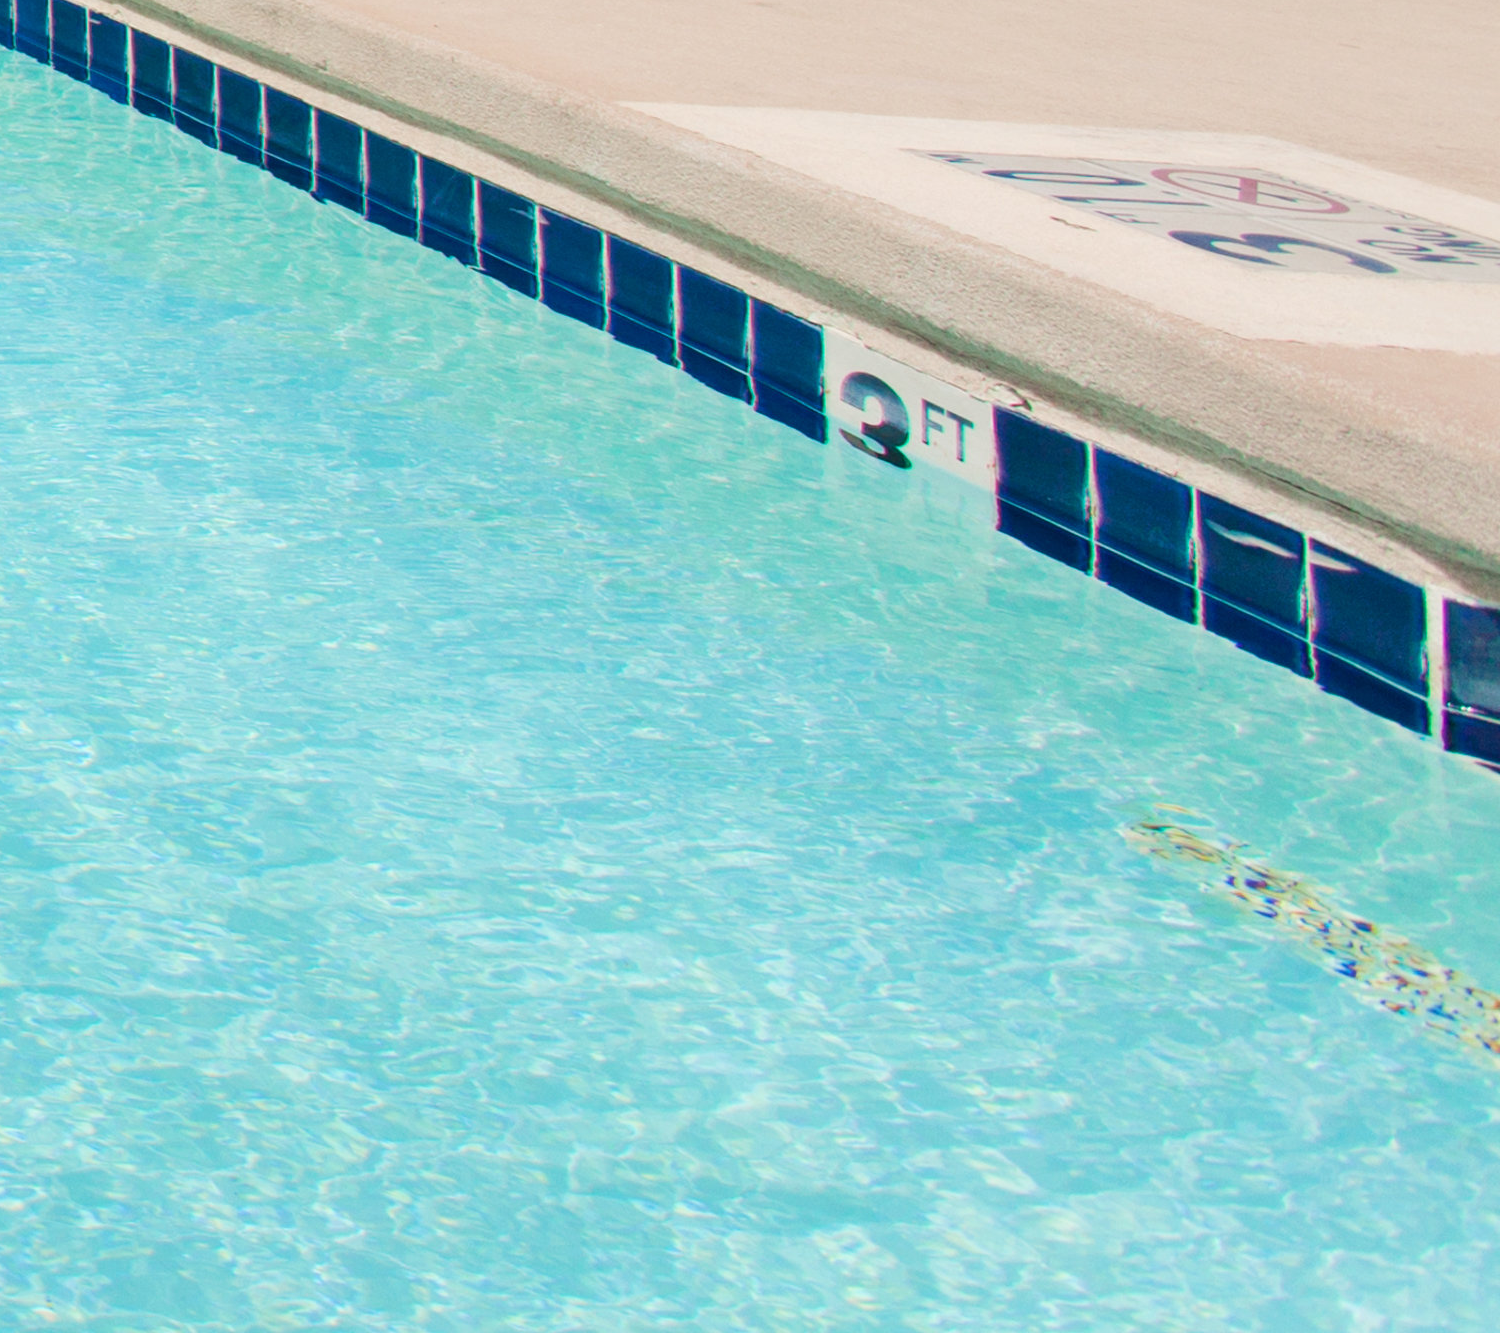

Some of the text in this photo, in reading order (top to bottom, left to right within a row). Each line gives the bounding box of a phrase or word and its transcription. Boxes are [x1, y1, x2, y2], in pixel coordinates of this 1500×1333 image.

[1094, 210, 1160, 225] FT
[1167, 230, 1398, 274] 3
[1356, 239, 1481, 266] NO
[839, 370, 975, 469] 3 FT
